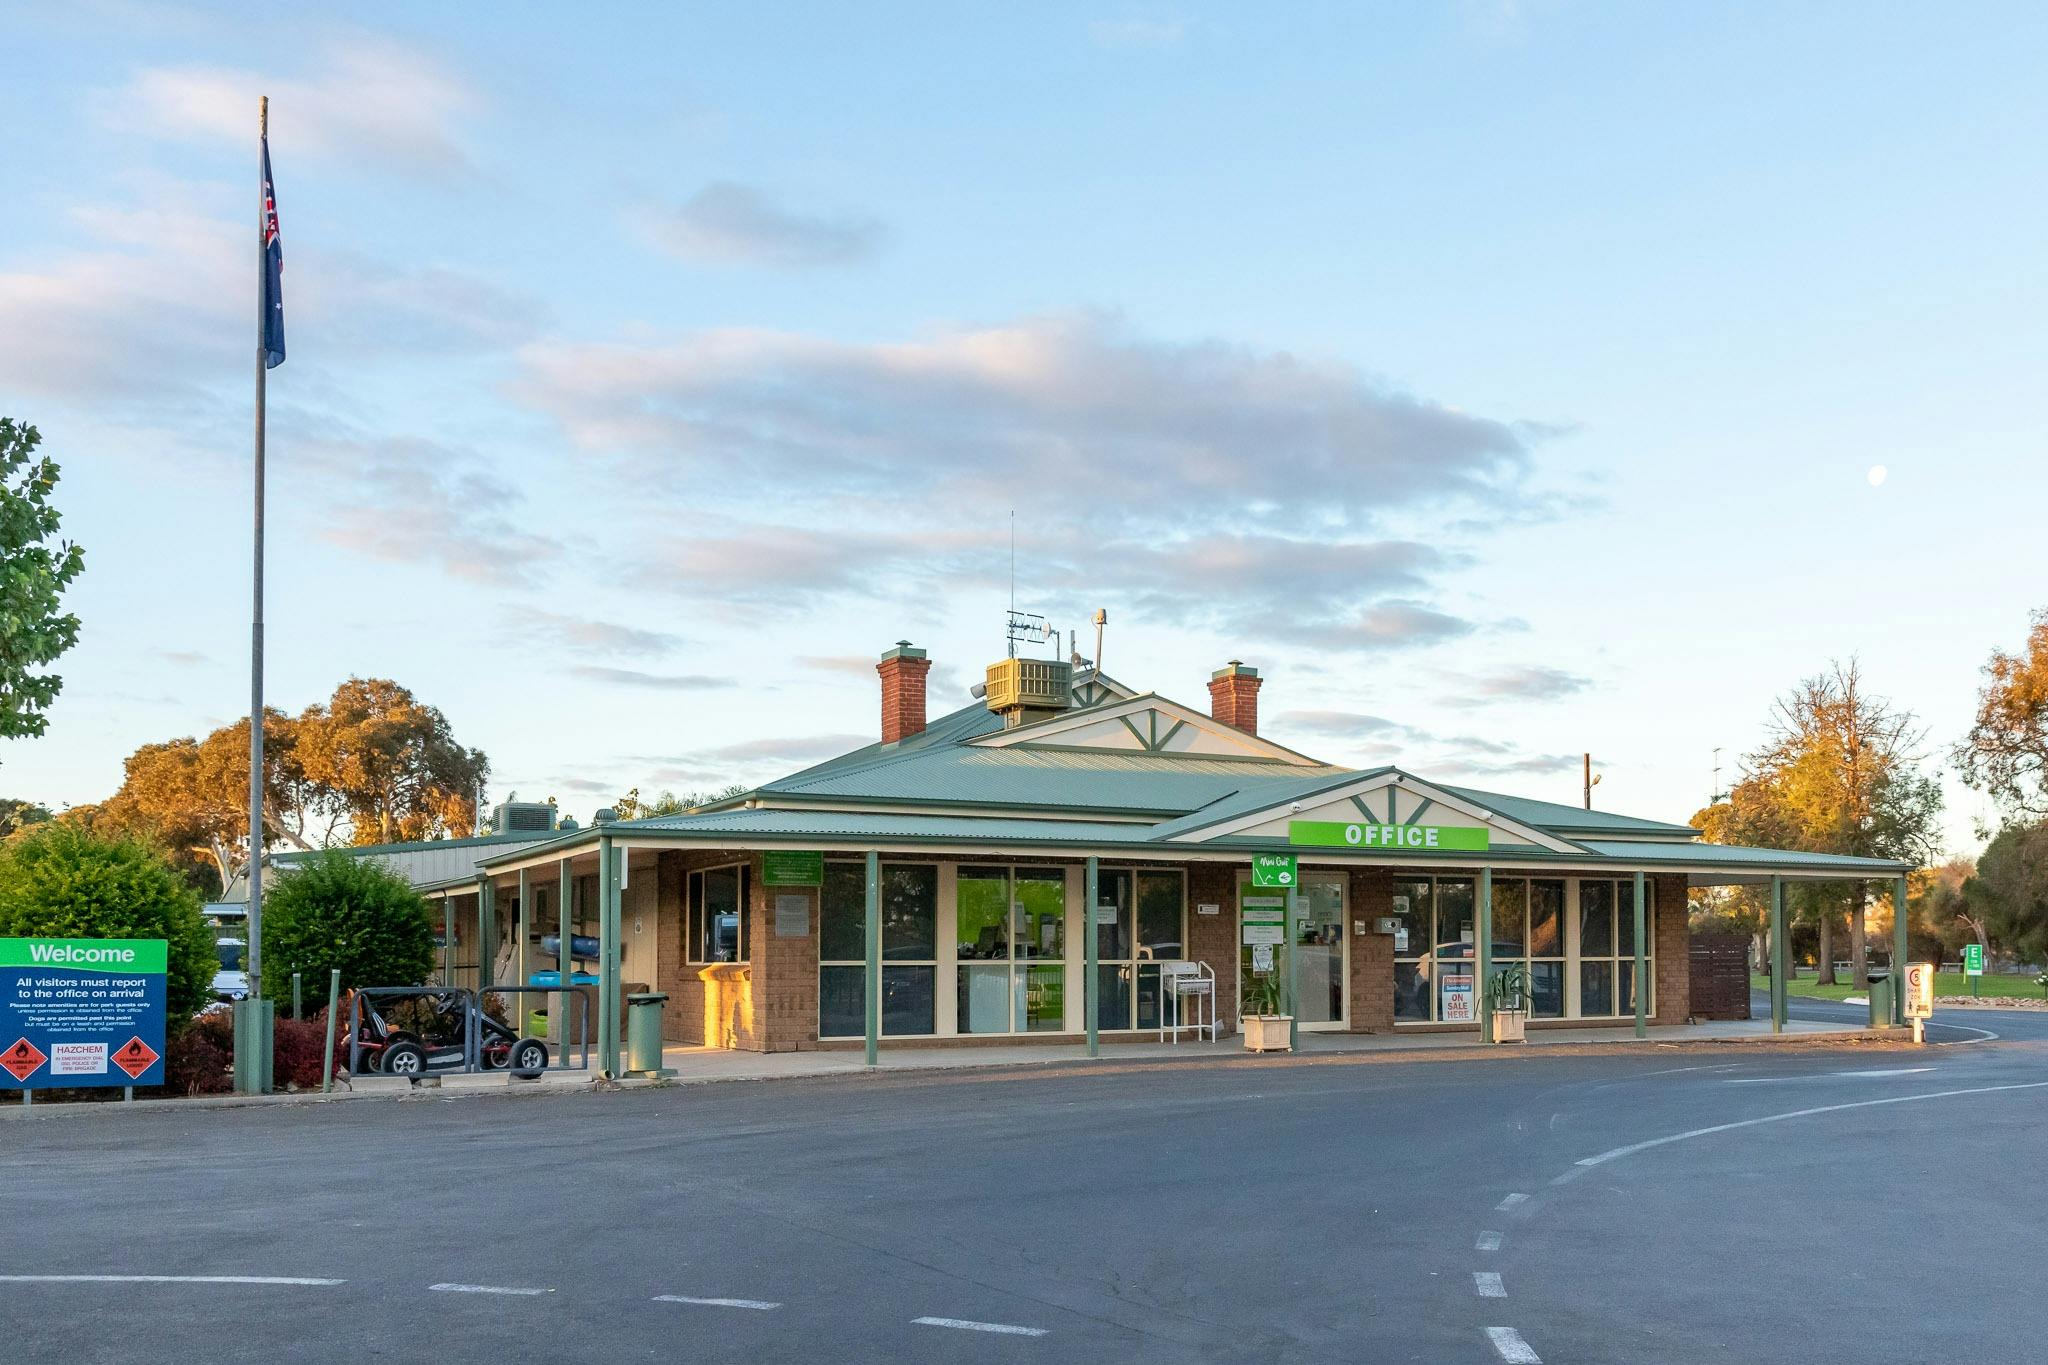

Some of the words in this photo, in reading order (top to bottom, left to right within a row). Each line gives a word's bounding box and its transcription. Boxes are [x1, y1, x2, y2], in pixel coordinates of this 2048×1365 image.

[1346, 824, 1439, 847] OFFICE
[1276, 857, 1290, 867] Golf
[30, 945, 135, 963] Welcome
[1971, 947, 1978, 958] E
[1914, 973, 1920, 982] 5
[17, 978, 31, 987] All
[36, 978, 78, 987] visitors
[81, 978, 109, 987] must
[112, 978, 146, 989] report
[18, 990, 31, 998] to
[34, 989, 53, 998] the
[56, 989, 88, 998] office
[92, 990, 107, 998] on
[110, 989, 144, 998] arrival
[1452, 993, 1464, 1001] ON
[1448, 1002, 1468, 1010] SALE
[1448, 1010, 1469, 1019] HERE
[57, 1046, 103, 1054] HAZCHEM
